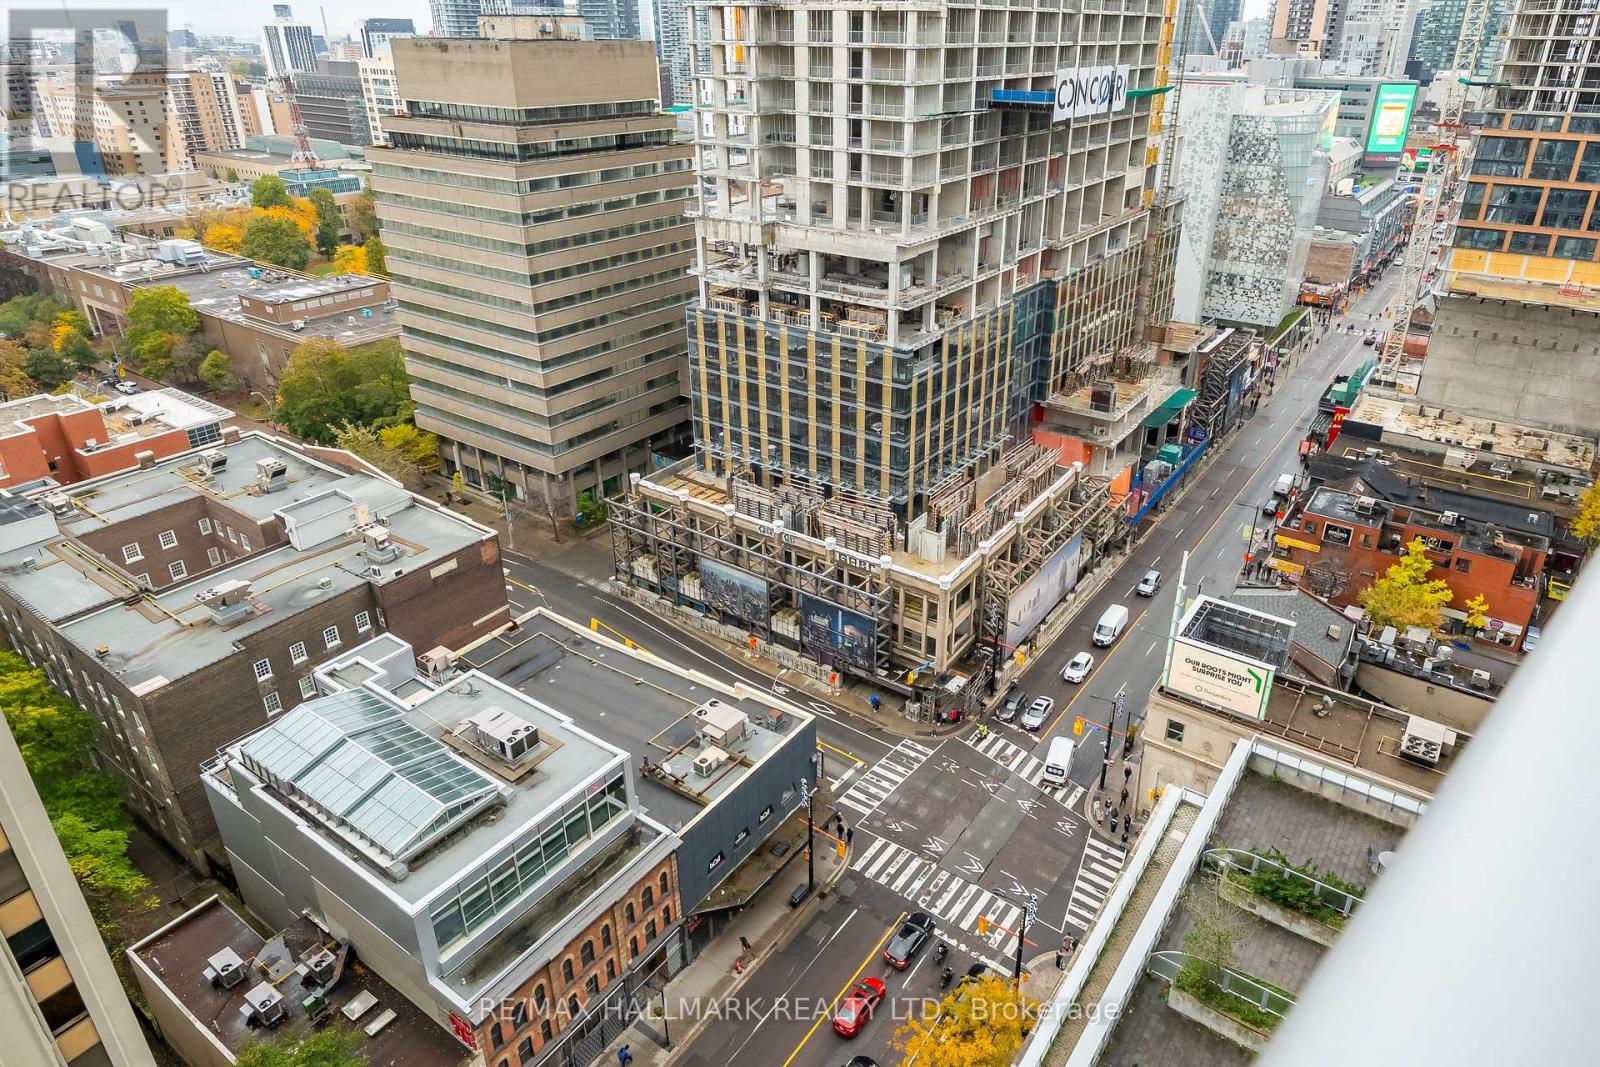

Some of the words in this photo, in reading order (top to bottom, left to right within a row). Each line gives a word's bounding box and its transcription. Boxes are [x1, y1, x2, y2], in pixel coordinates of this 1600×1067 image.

[1185, 657, 1200, 667] OUR
[1201, 663, 1227, 675] ROOTS
[1227, 671, 1252, 683] MIGHT
[1192, 666, 1225, 681] SURPRISE
[1227, 677, 1243, 687] YOU
